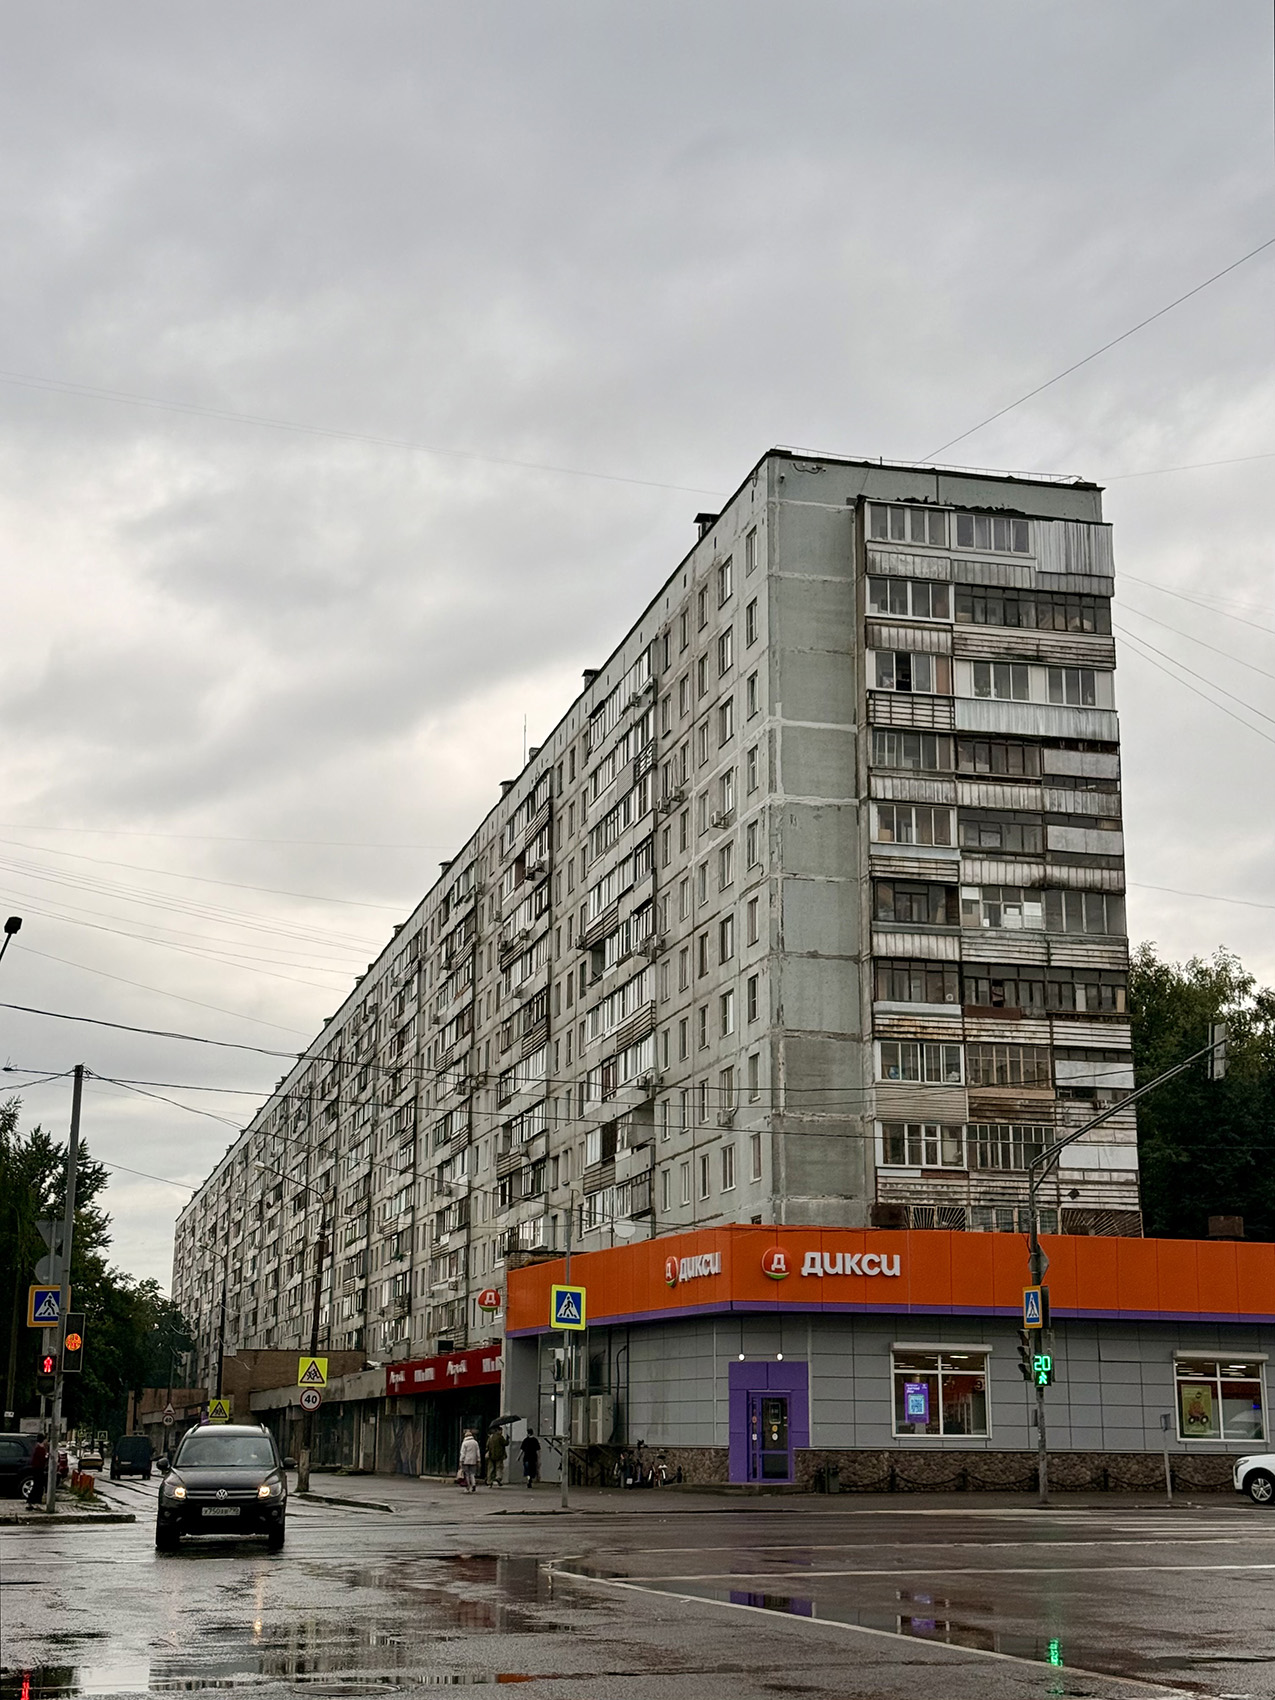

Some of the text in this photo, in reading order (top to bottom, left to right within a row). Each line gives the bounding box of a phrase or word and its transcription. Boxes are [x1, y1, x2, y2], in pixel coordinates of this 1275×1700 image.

[771, 1253, 786, 1271] Д
[484, 1292, 496, 1305] Д
[1034, 1355, 1051, 1371] 20
[304, 1395, 318, 1404] 40
